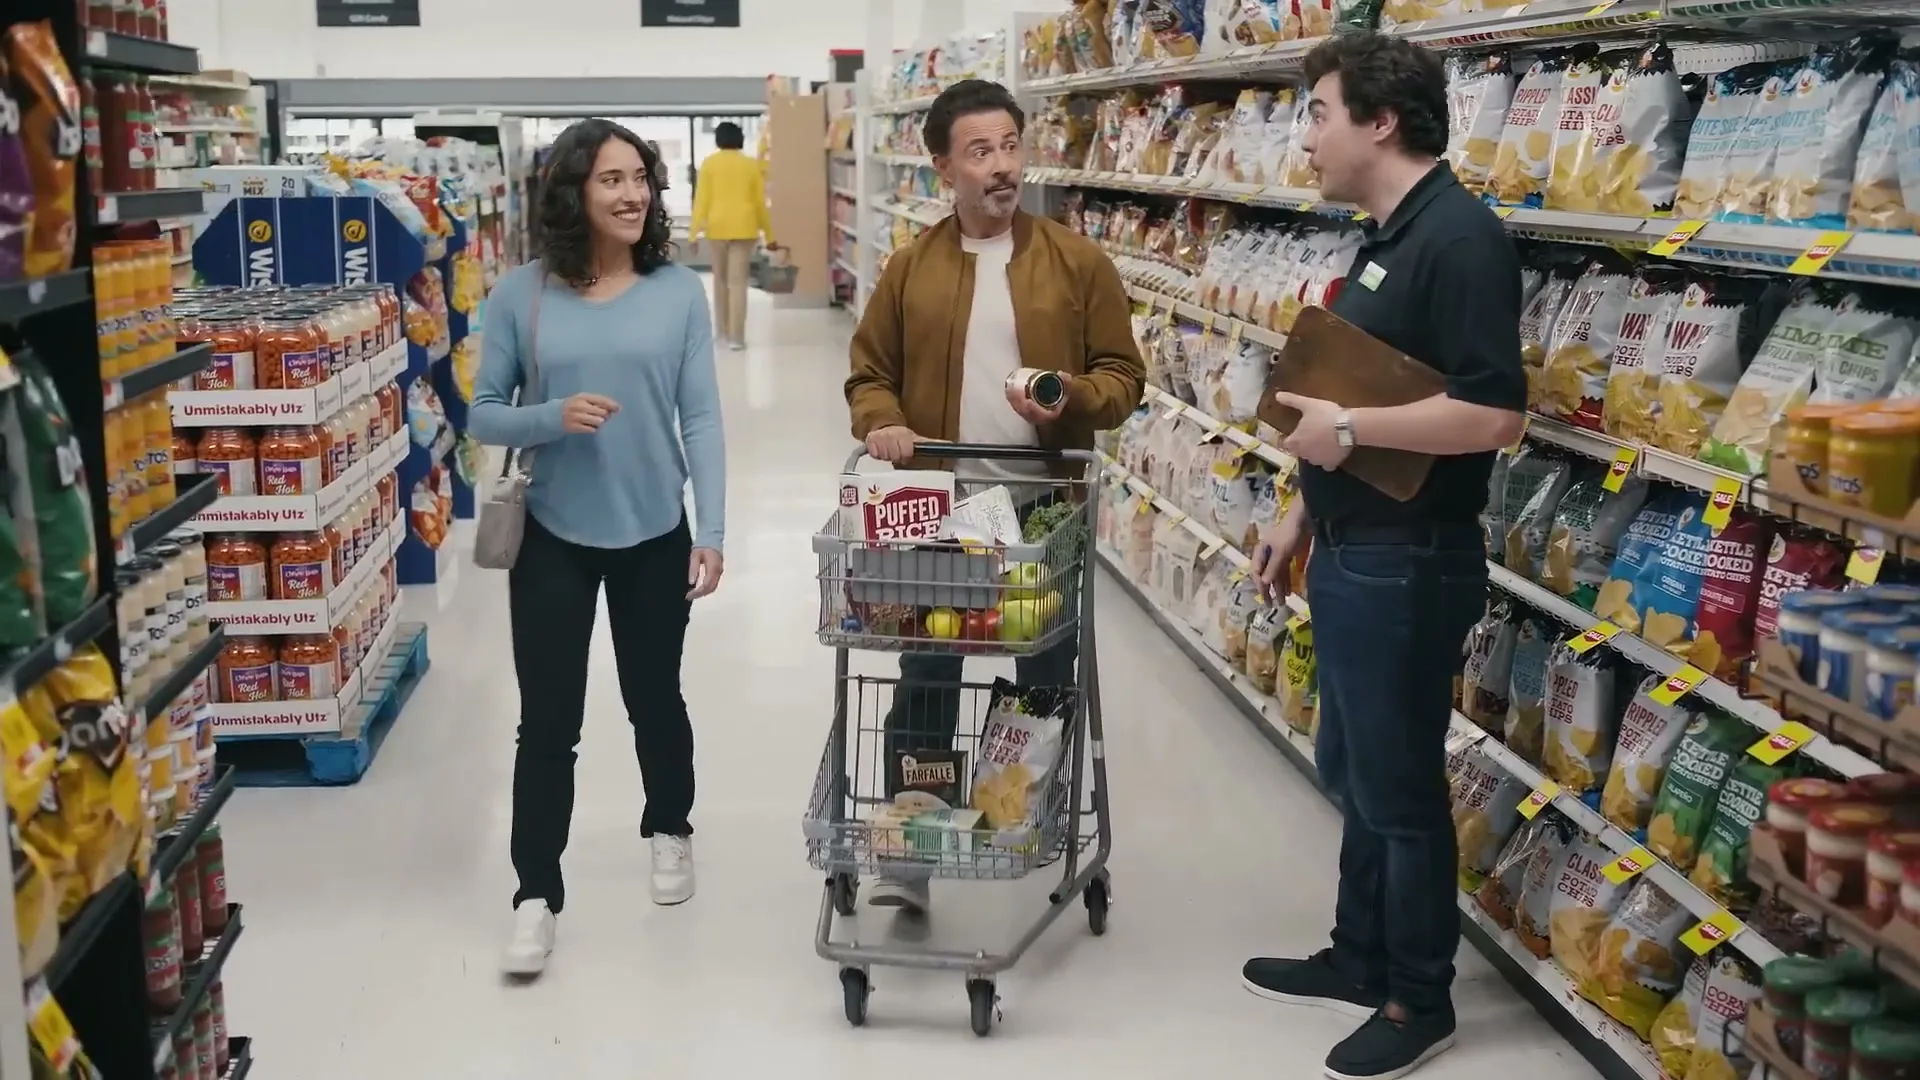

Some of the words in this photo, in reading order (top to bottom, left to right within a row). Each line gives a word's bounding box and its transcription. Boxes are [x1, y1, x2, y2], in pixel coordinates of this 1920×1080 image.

[1669, 232, 1688, 241] SALE
[1809, 245, 1833, 255] SALE
[290, 366, 311, 379] Red
[1839, 360, 1881, 382] CHIPS
[183, 402, 279, 417] Unmistakably
[281, 402, 304, 414] Utz
[1613, 461, 1629, 471] SALE
[266, 475, 286, 486] Red
[275, 484, 297, 495] Hot
[1714, 492, 1734, 504] SALE
[282, 509, 305, 520] Utz
[875, 496, 940, 528] PUFFED
[875, 519, 941, 546] RICE
[288, 578, 309, 590] Red
[1726, 572, 1751, 584] CHIPS
[297, 586, 319, 598] Hot
[294, 613, 317, 624] Utz
[1586, 630, 1605, 642] SALE
[237, 681, 260, 693] Red
[1670, 677, 1690, 690] SALE
[248, 689, 268, 701] Hot
[211, 712, 303, 728] Unmistakably
[305, 712, 328, 723] Utz
[1771, 733, 1797, 748] SALE
[905, 766, 953, 783] FARFALLE
[1620, 856, 1641, 871] SALE
[1701, 922, 1726, 939] SALE
